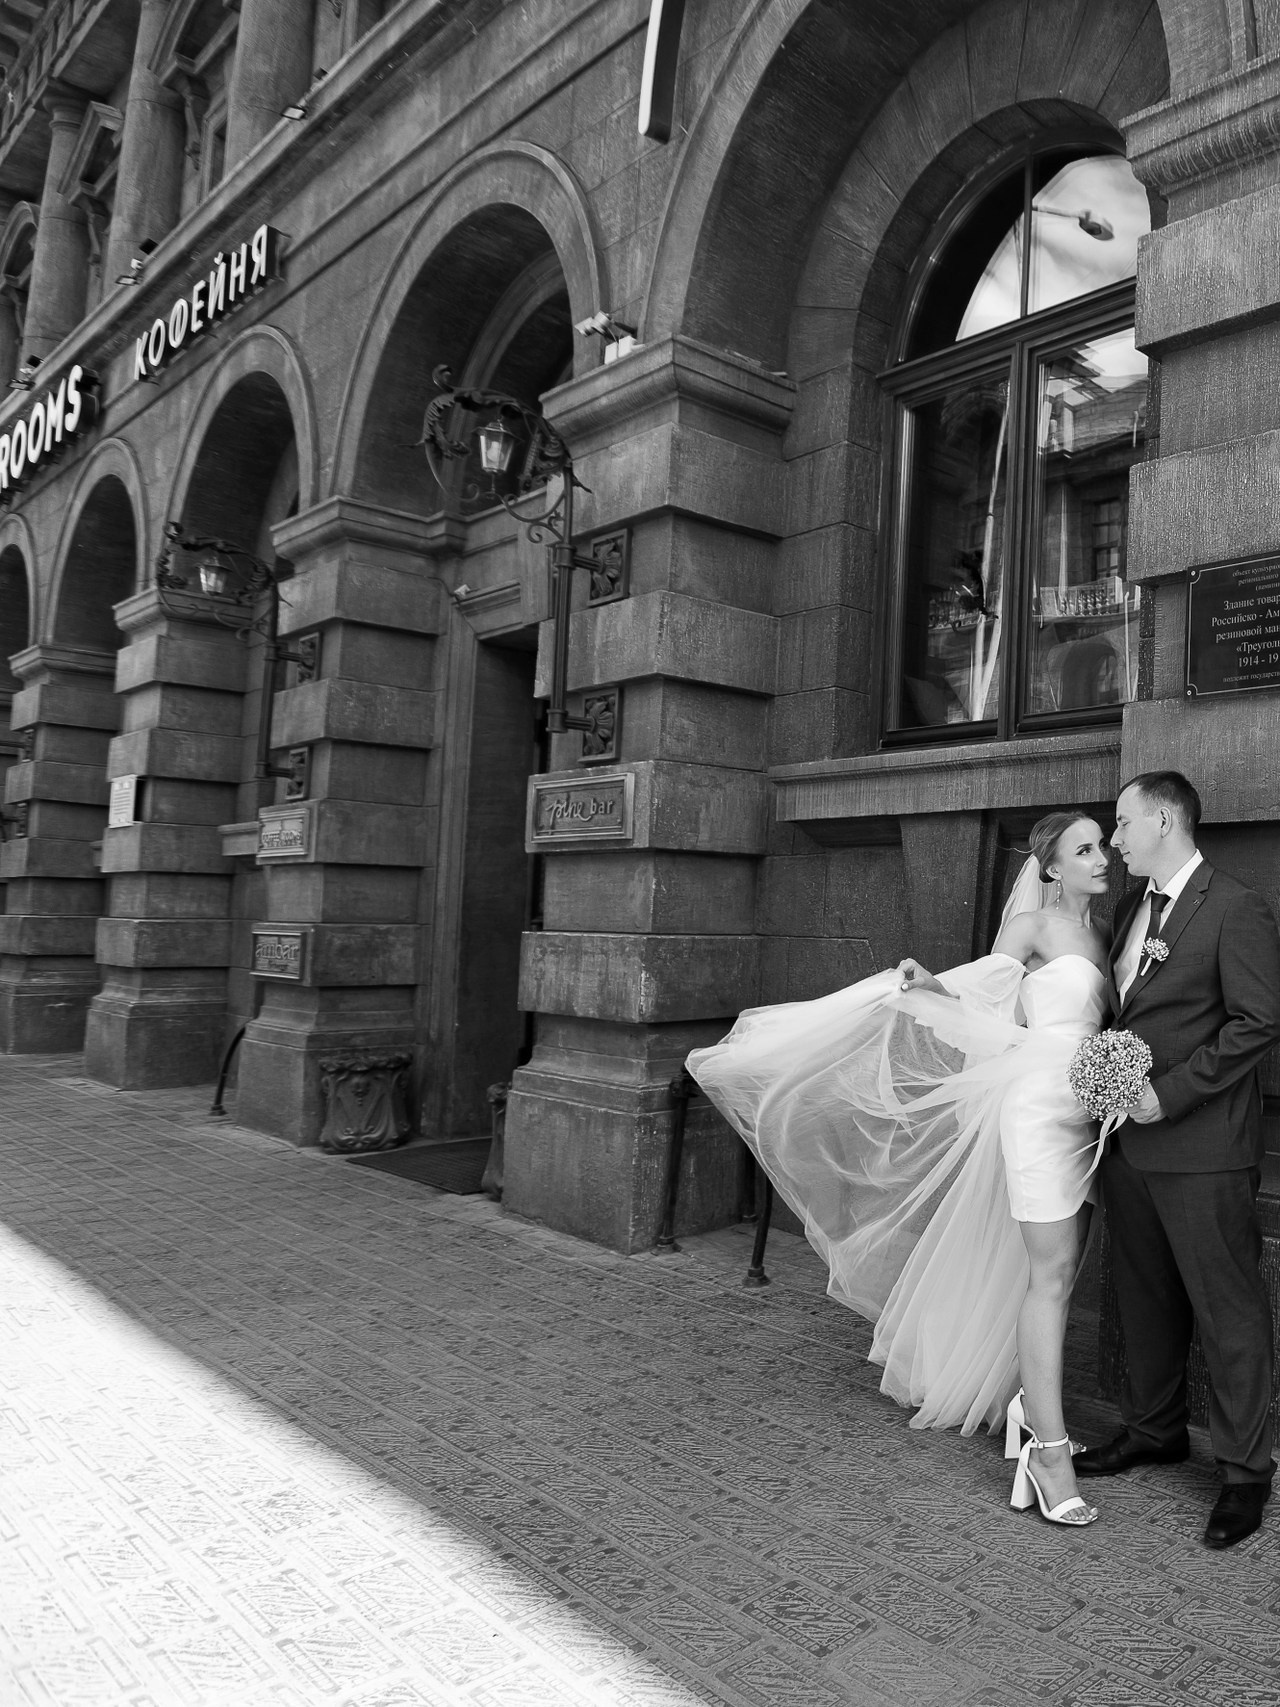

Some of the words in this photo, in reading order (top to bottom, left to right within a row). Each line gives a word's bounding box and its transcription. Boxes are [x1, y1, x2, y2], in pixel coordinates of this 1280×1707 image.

[134, 224, 268, 381] КОФЕЙНЯ
[0, 364, 83, 491] ROOMS
[1223, 599, 1255, 611] Здание
[1211, 612, 1257, 627] Российско
[1215, 625, 1262, 643] резиновой
[1238, 655, 1259, 668] 1914
[590, 797, 614, 814] bar
